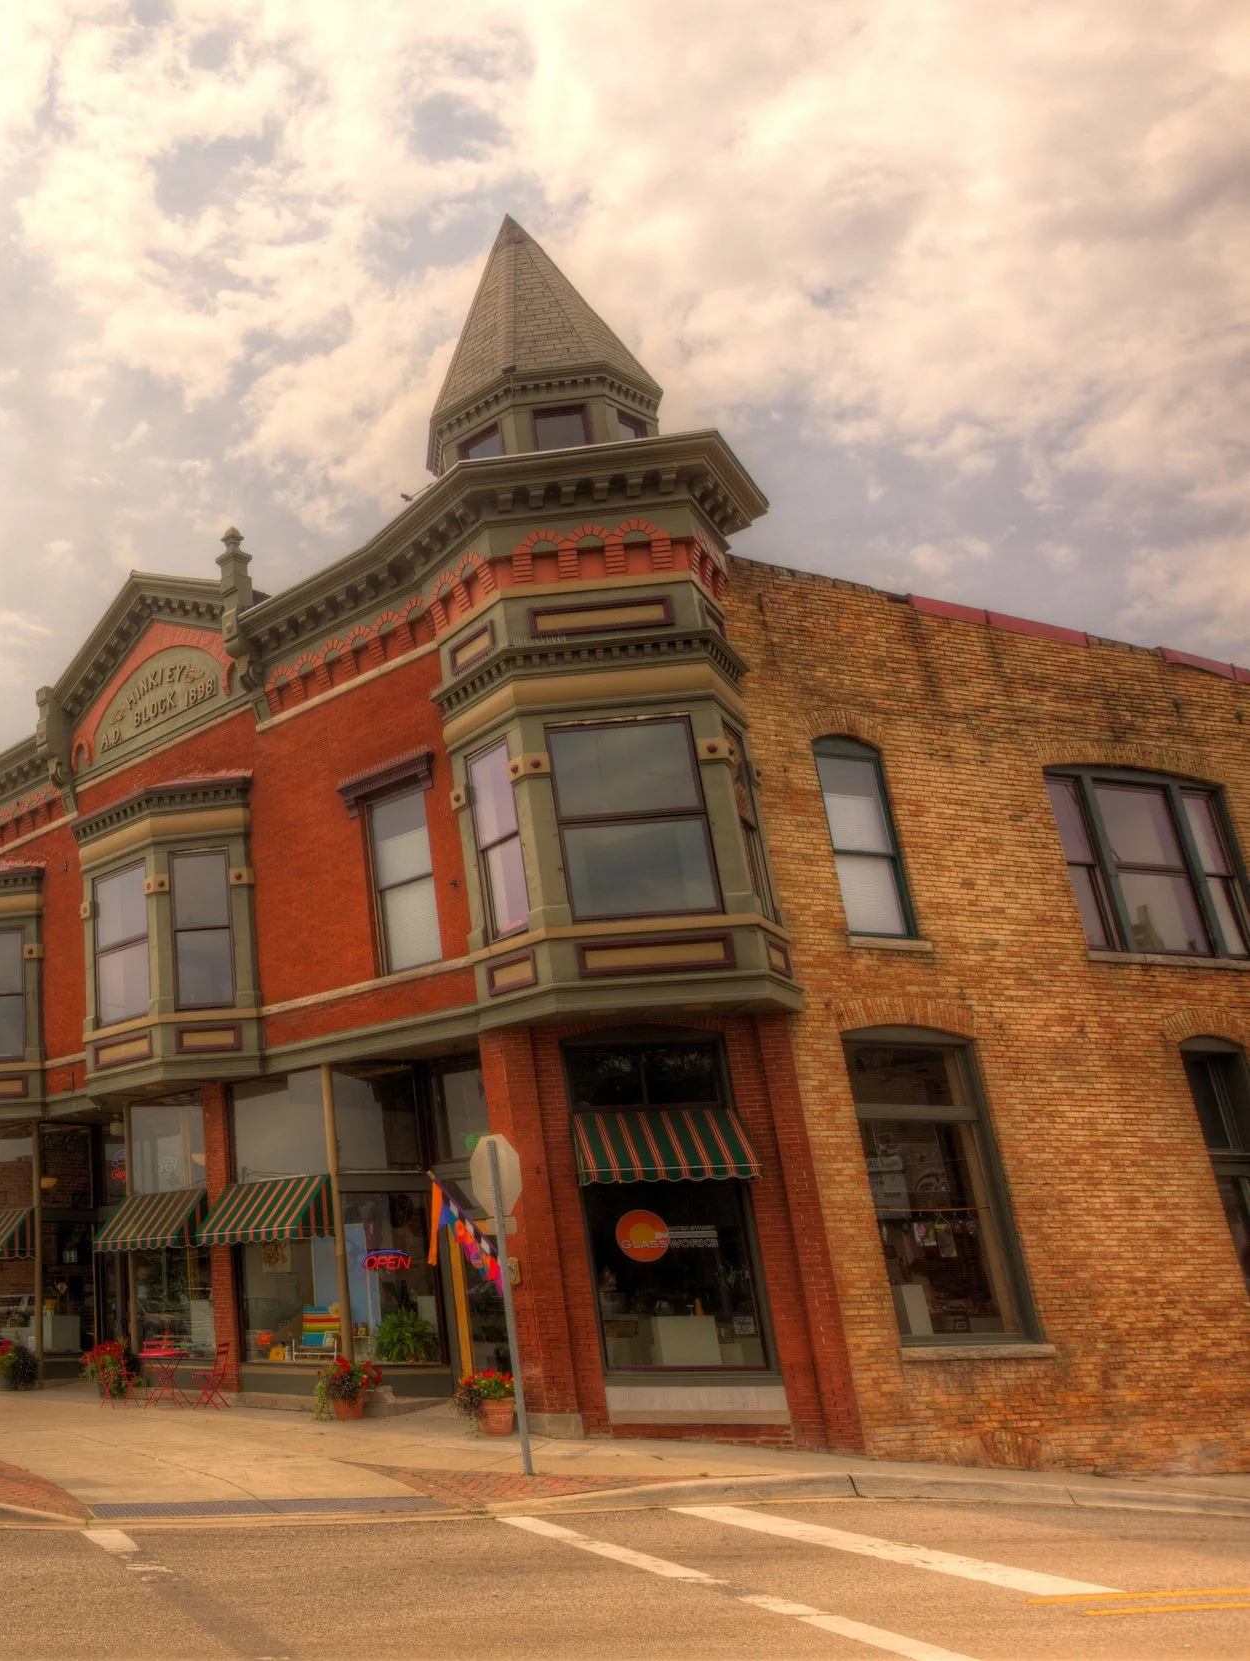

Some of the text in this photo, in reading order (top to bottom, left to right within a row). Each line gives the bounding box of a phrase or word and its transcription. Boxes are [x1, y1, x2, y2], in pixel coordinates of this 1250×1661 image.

[134, 690, 177, 728] BLOCK
[185, 678, 214, 707] 1898
[364, 1255, 413, 1271] OPEN
